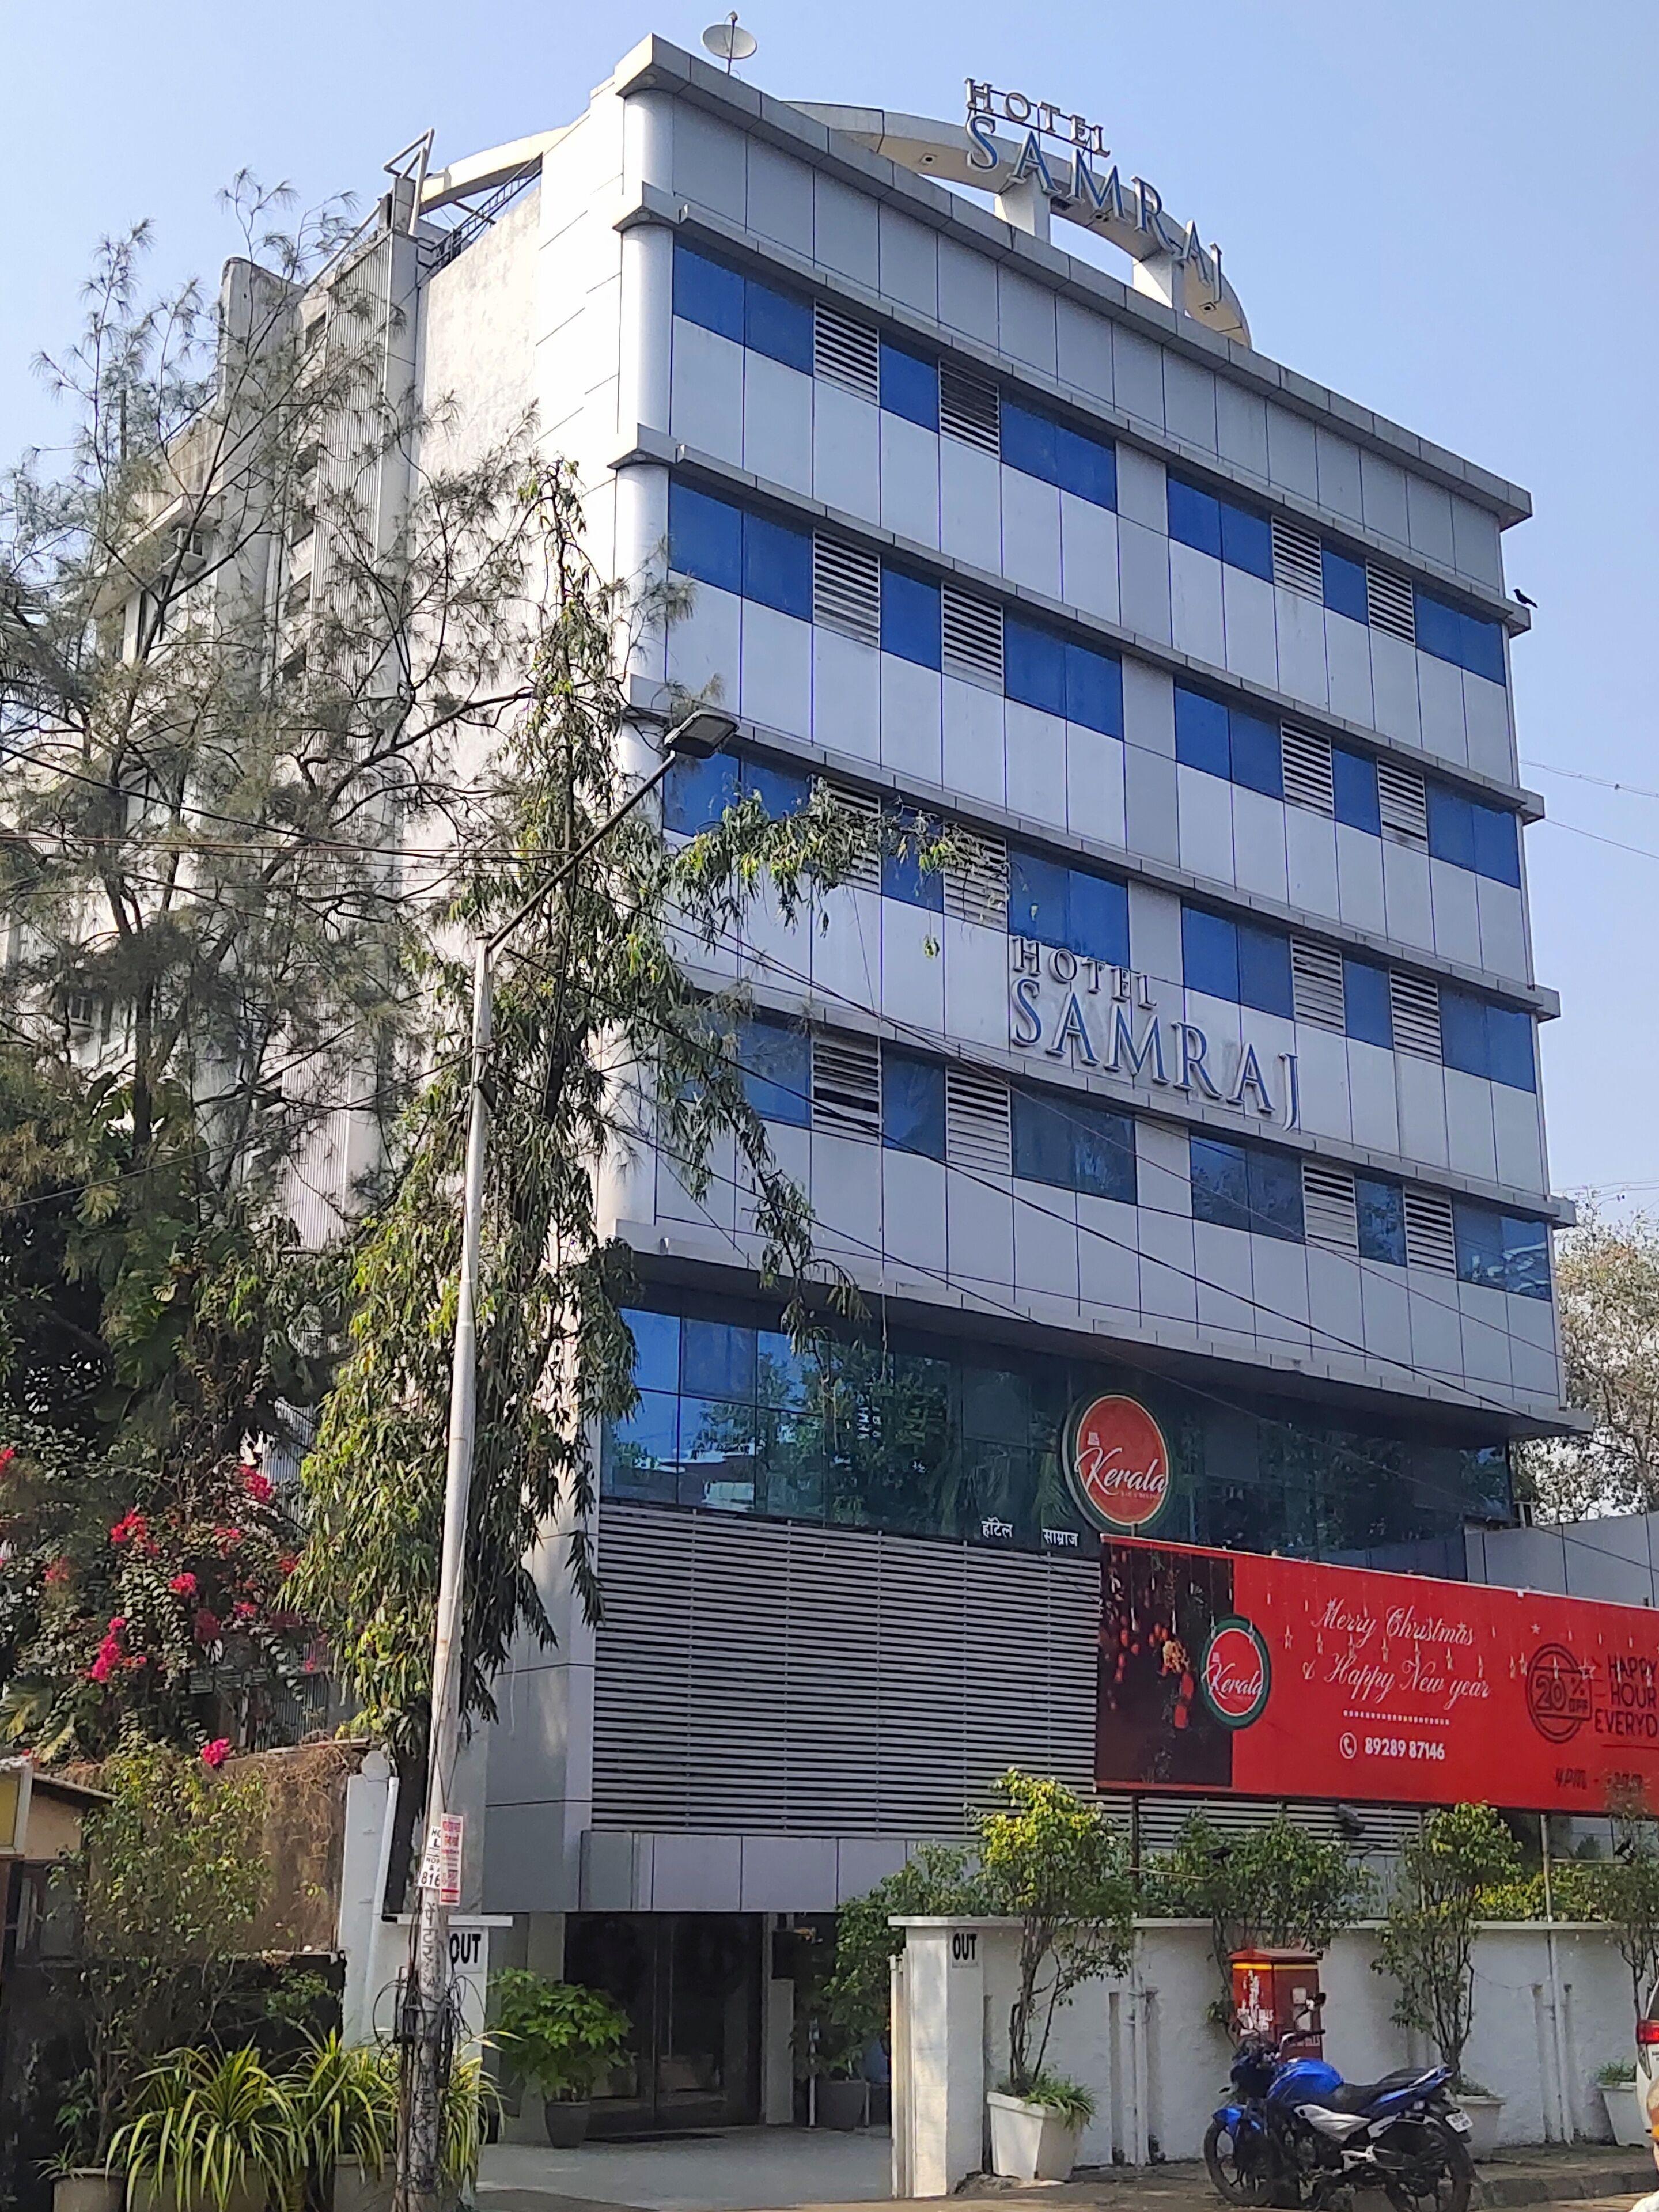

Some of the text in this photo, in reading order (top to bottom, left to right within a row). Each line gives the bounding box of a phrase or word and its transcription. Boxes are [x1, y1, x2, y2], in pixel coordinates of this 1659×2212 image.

[965, 78, 1110, 157] HOTEL
[965, 115, 1222, 303] SAMRAJ
[1012, 935, 1157, 1010] HOTEL
[1011, 977, 1299, 1132] SAMRAJ
[1074, 1447, 1169, 1495] Kerala
[981, 1516, 1013, 1538] हॉटेल
[1312, 1597, 1474, 1648] Merry Christmas
[1201, 1662, 1263, 1699] Kerala
[1324, 1653, 1395, 1703] Happy
[1400, 1660, 1444, 1693] New
[1443, 1680, 1490, 1710] year
[1607, 1653, 1657, 1683] HAPPY
[1611, 1681, 1657, 1709] HOUR
[1365, 1737, 1445, 1760] 89289 87146
[450, 1933, 482, 1964] OUT
[953, 1933, 977, 1960] OUT
